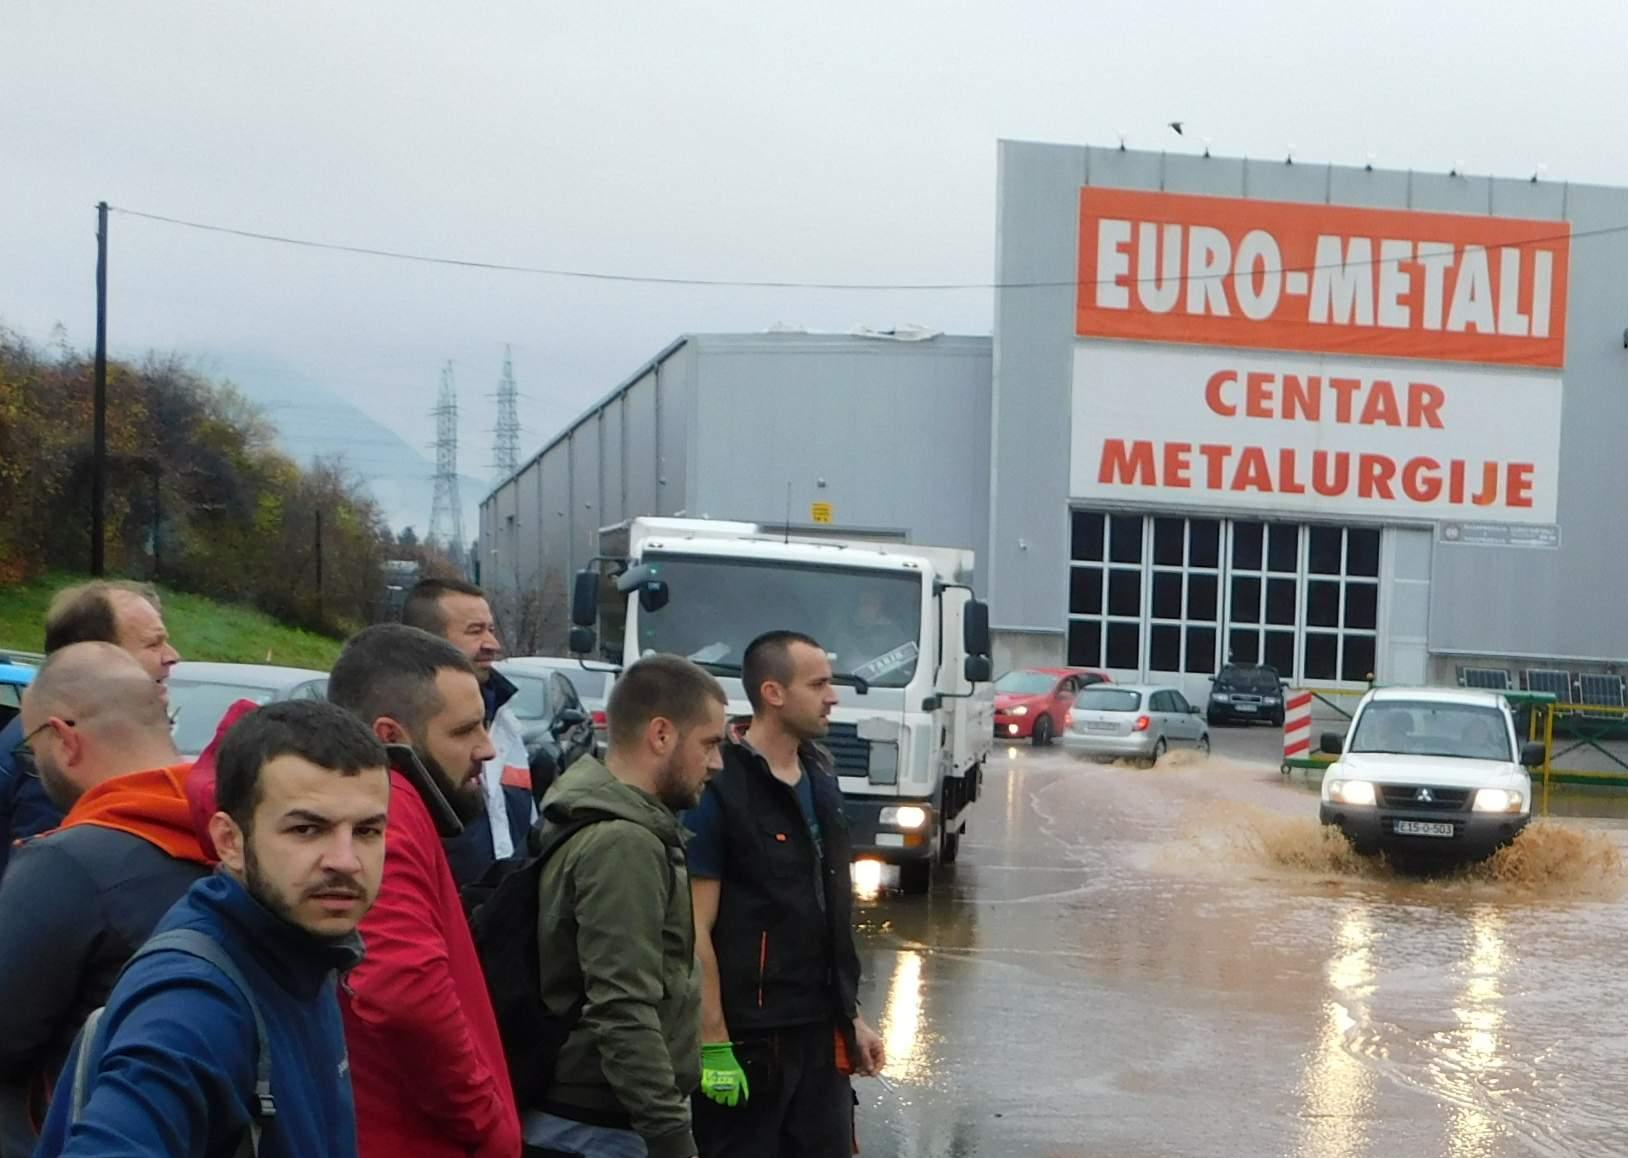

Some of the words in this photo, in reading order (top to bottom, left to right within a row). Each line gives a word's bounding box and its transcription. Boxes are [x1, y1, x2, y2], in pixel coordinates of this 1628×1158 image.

[1096, 219, 1553, 338] EURO-METALI
[1204, 369, 1446, 429] CENTAR
[1097, 438, 1535, 508] METALURGIJE
